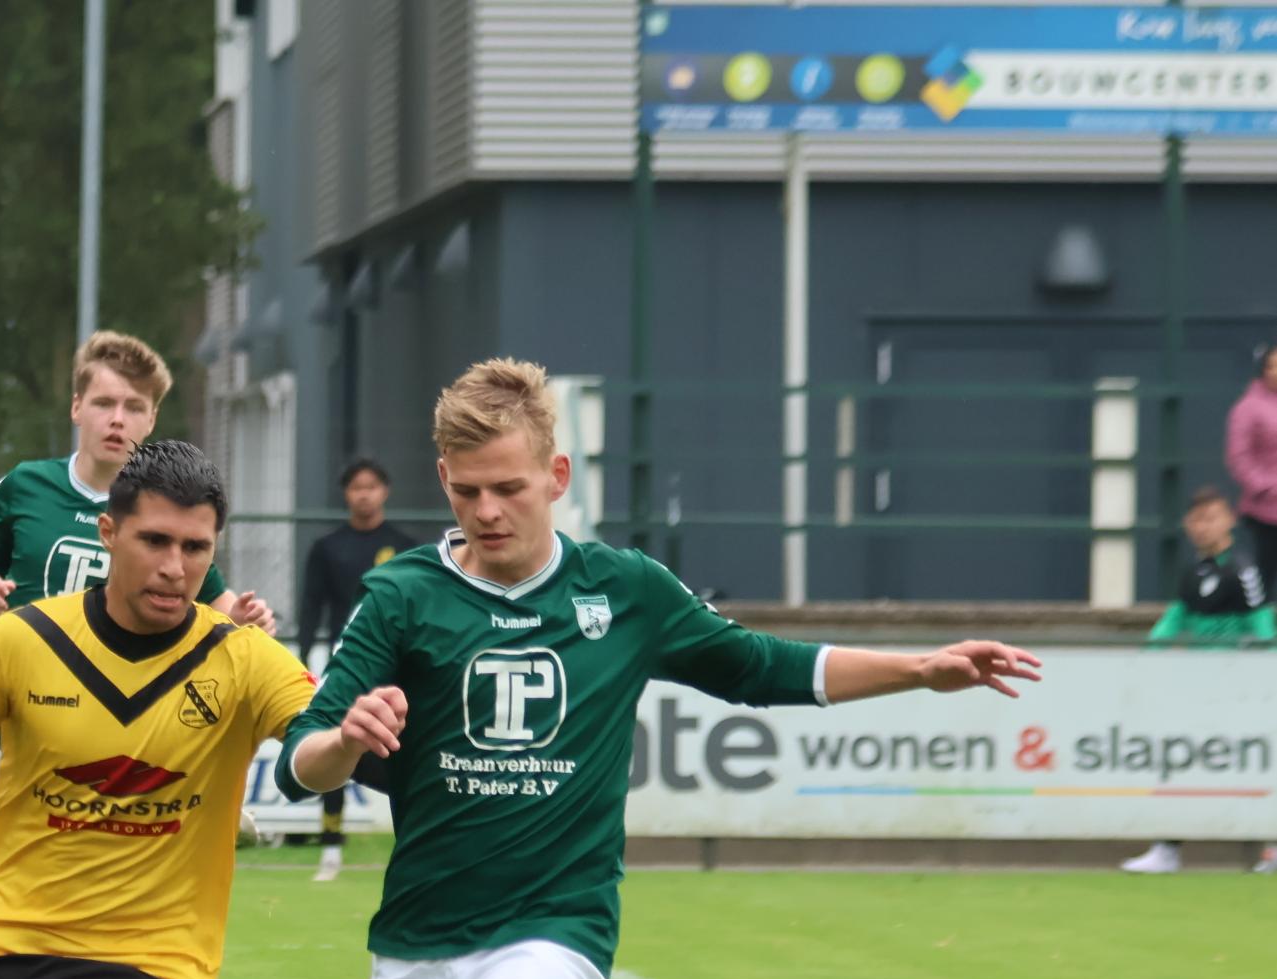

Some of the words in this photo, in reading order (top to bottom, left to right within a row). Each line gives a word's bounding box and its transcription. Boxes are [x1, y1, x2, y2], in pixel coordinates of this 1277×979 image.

[491, 613, 542, 630] hummel
[27, 690, 80, 708] hummel
[439, 751, 576, 774] Kraanverhuur
[799, 731, 997, 769] wonen
[1014, 726, 1056, 771] &
[1073, 724, 1270, 780] slapen
[446, 776, 463, 794] T.
[467, 778, 519, 796] Pater
[32, 783, 202, 817] HOORNSTRA
